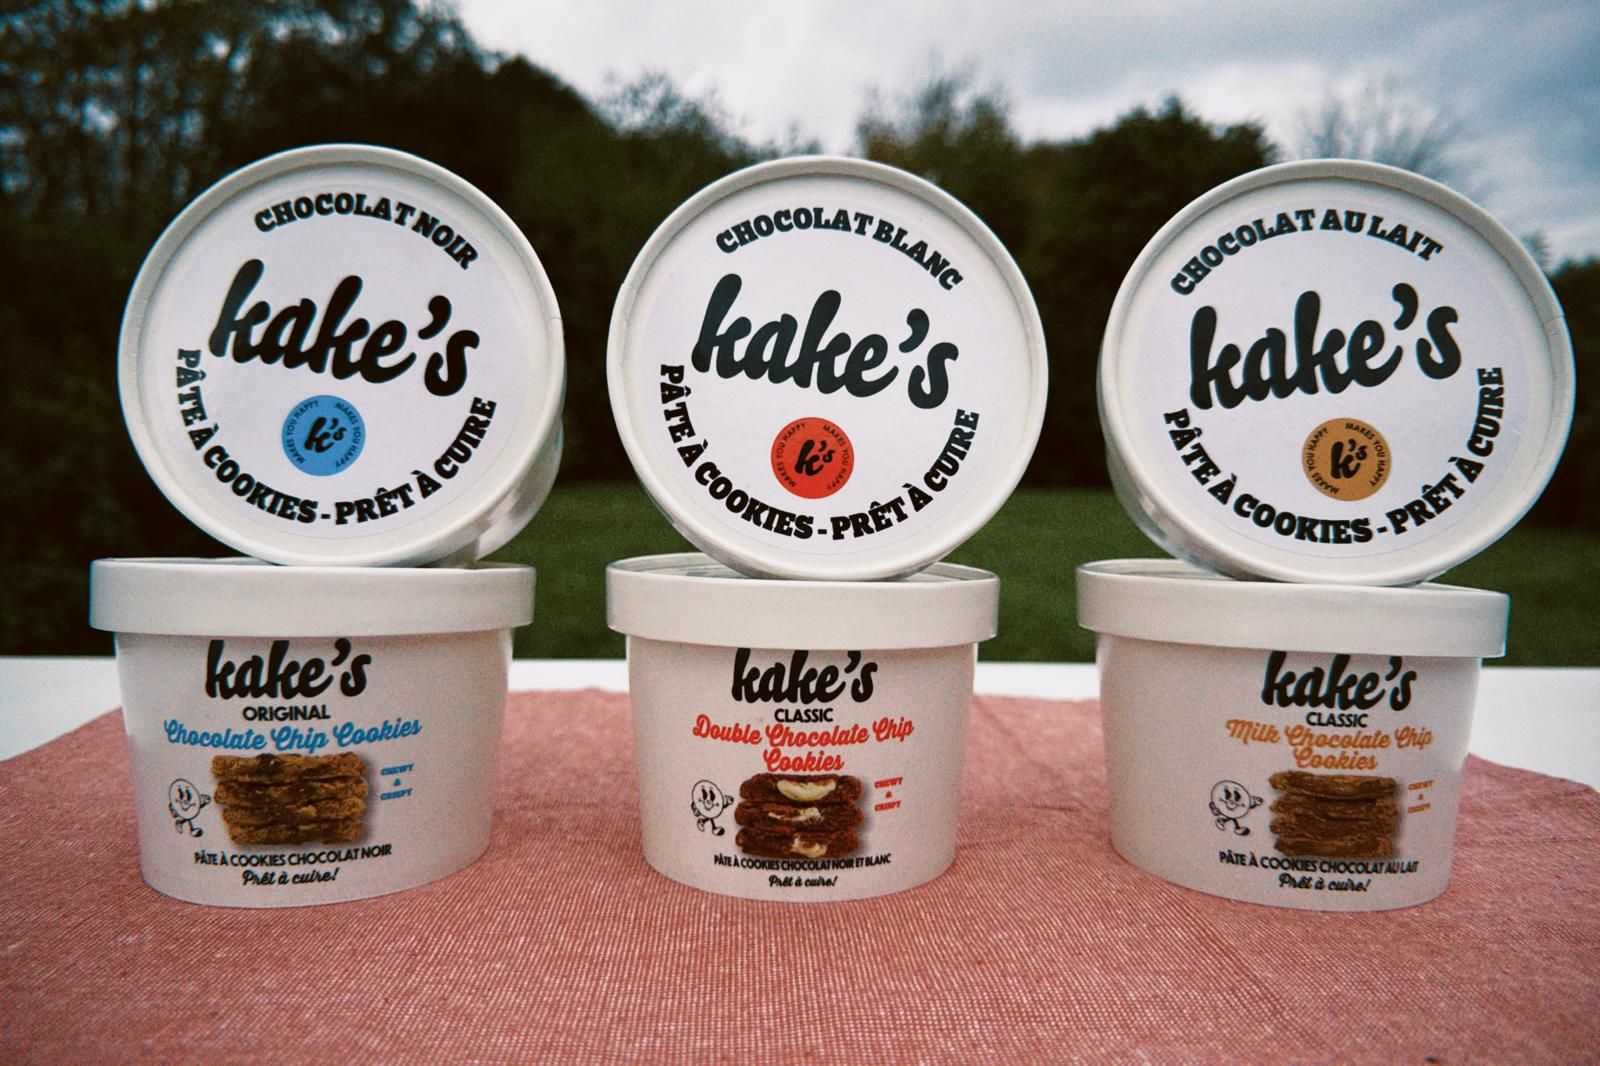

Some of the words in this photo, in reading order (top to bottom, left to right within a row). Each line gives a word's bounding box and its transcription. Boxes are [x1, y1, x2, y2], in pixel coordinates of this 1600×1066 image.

[254, 193, 416, 233] CHOCOLAT
[412, 209, 478, 270] NOIR
[716, 207, 874, 253] CHOCOLAT
[874, 220, 964, 291] BLANC
[1170, 209, 1315, 296] CHOCOLAT
[1320, 209, 1366, 233] AU
[1367, 215, 1444, 261] LAIT
[209, 259, 480, 396] kake's
[691, 273, 959, 409] kake's
[1190, 282, 1462, 410] kake's
[176, 348, 206, 427] PÂTE
[660, 363, 695, 444] PÂTE
[190, 422, 220, 451] À
[287, 419, 297, 435] YOU
[434, 397, 497, 479] CUIRE
[1345, 423, 1375, 440] MAKES
[1373, 440, 1385, 457] YOU
[677, 440, 709, 468] À
[776, 442, 785, 458] YOU
[923, 409, 979, 492] CUIRE
[1163, 408, 1220, 487] PÂTE
[1208, 472, 1240, 505] À
[1233, 493, 1374, 544] COOKIES
[1385, 472, 1468, 535] PRÊT
[1448, 455, 1485, 483] À
[1467, 367, 1505, 458] CUIRE
[1307, 453, 1315, 472] YOU
[204, 446, 318, 523] COOKIES
[411, 469, 442, 499] À
[902, 483, 933, 513] À
[335, 487, 416, 525] PRÊT
[694, 462, 814, 540] COOKIES
[831, 496, 907, 540] PRÊT
[205, 638, 372, 700] kake's
[243, 705, 330, 721] ORIGINAL
[774, 708, 833, 723] CLASSIC
[1306, 712, 1368, 728] CLASSIC
[164, 719, 267, 750] Chocolate
[271, 725, 329, 753] Chip
[333, 718, 423, 747] Cookies
[693, 714, 763, 746] Double
[765, 723, 870, 747] Chocolate
[872, 716, 914, 742] Chip
[1226, 719, 1280, 746] Milk
[1284, 724, 1391, 749] Chocolate
[1393, 726, 1434, 750] Chip
[763, 747, 845, 772] Cookies
[1292, 748, 1378, 770] Cookies
[194, 850, 218, 865] PÂTE
[220, 850, 228, 866] À
[231, 854, 286, 867] COOKIES
[288, 849, 361, 866] CHOCOLAT
[361, 844, 392, 859] NOIR
[714, 853, 732, 866] PÂTE
[733, 854, 740, 867] À
[741, 858, 779, 870] COOKIES
[781, 859, 831, 871] CHOCOLAT
[831, 858, 855, 869] NOIR
[855, 857, 865, 868] ET
[865, 853, 891, 867] BLANC
[1219, 850, 1246, 865] PÂTE
[1249, 851, 1258, 867] À
[1260, 856, 1317, 873] COOKIES
[1319, 860, 1384, 874] CHOCOLAT
[243, 869, 276, 885] Prêt
[278, 870, 289, 884] à
[292, 867, 340, 883] cuire!
